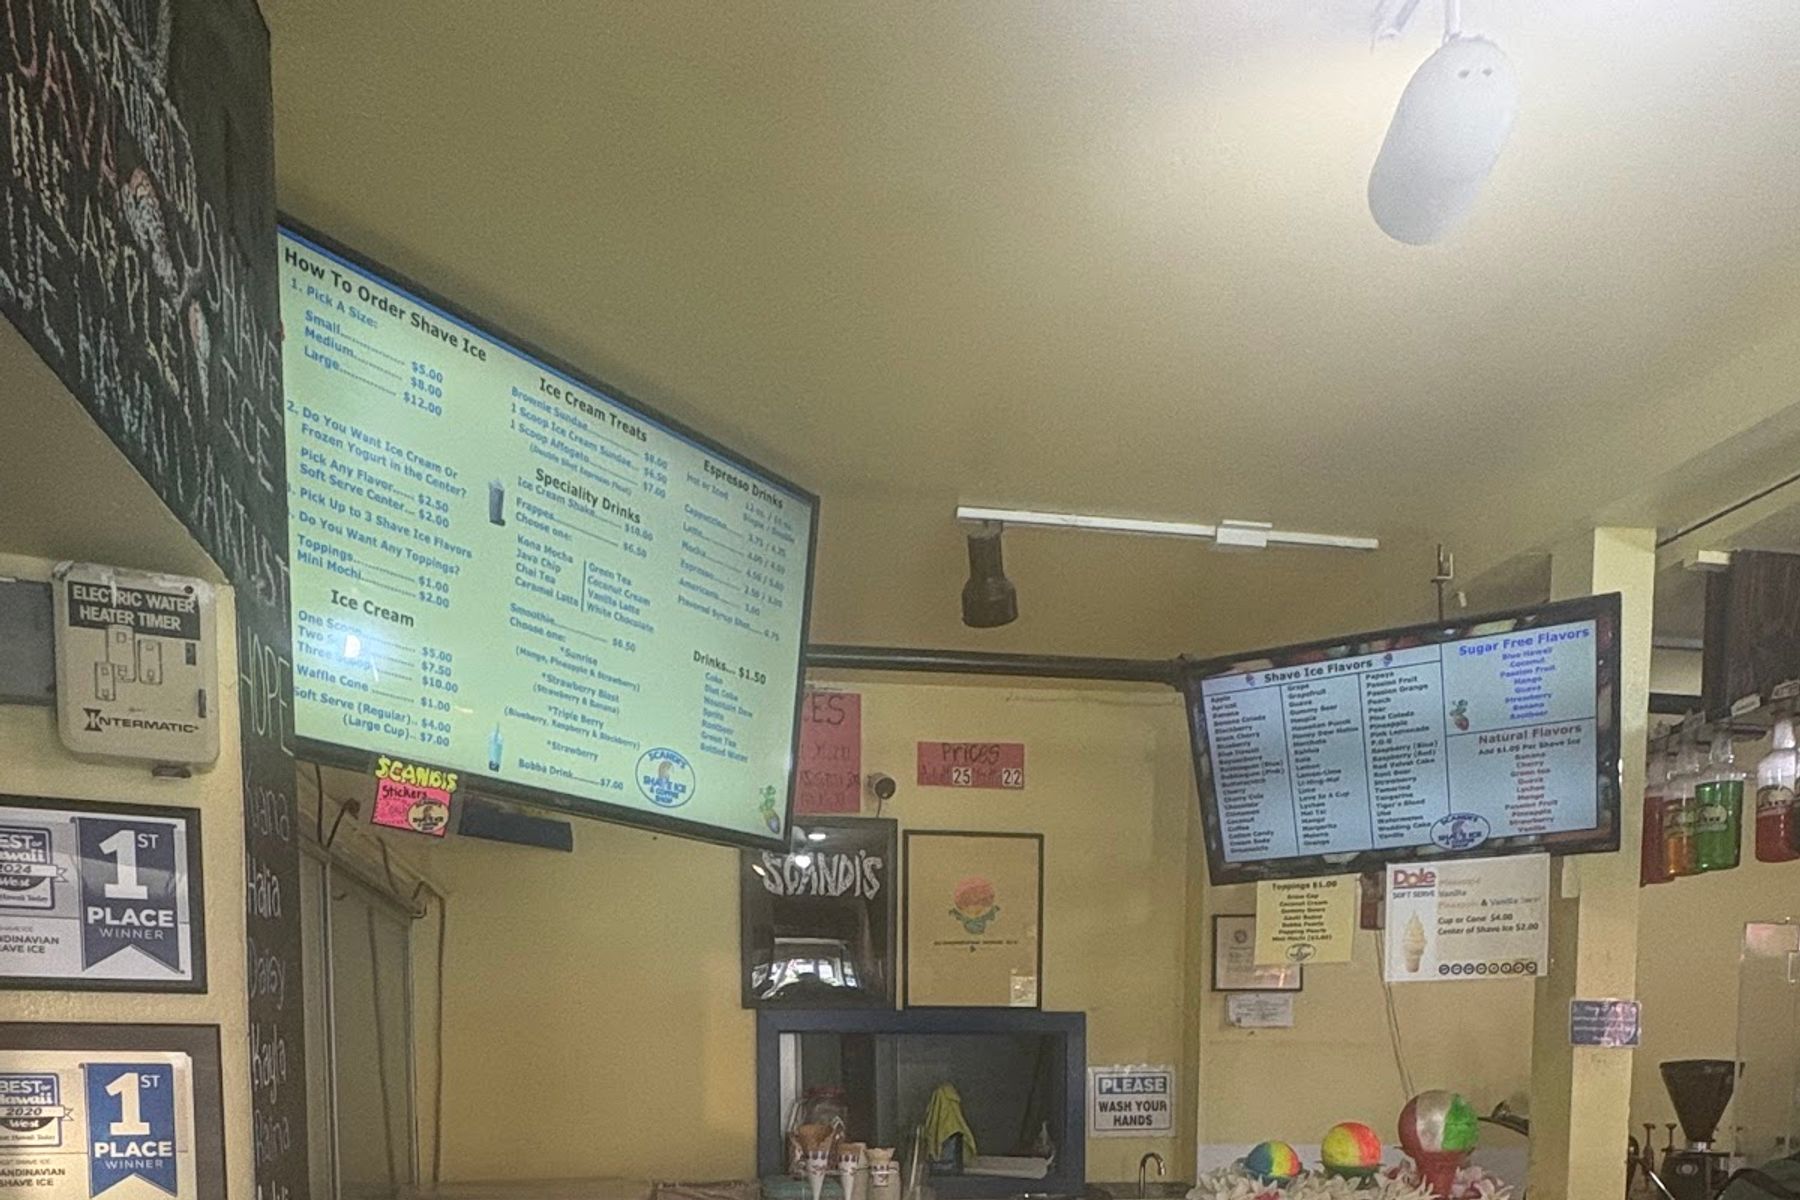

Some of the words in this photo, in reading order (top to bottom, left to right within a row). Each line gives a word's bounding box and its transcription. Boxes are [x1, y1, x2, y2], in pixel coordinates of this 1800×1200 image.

[203, 202, 283, 422] SHAVE
[285, 247, 325, 280] How
[330, 270, 352, 294] To
[358, 286, 406, 320] Order
[411, 312, 458, 347] Shave
[462, 337, 487, 361] Ice
[306, 285, 333, 307] Pick
[336, 301, 345, 313] A
[348, 306, 378, 328] Size:
[305, 326, 355, 358] Medium
[305, 310, 340, 335] Small
[411, 361, 444, 383] $5.00
[304, 346, 340, 372] Large
[403, 391, 443, 416] $12.00
[221, 355, 274, 493] ICE
[539, 377, 561, 399] Ice
[565, 391, 606, 421] Cream
[609, 412, 648, 442] Treats
[302, 406, 320, 423] Do
[323, 415, 347, 434] You
[350, 426, 382, 448] Want
[385, 441, 404, 458] Ice
[406, 450, 443, 473] Cream
[444, 467, 458, 480] Or
[301, 423, 344, 449] Frozen
[348, 441, 387, 467] Yogurt
[390, 459, 401, 471] in
[404, 463, 423, 482] the
[425, 473, 468, 498] Center?
[299, 463, 326, 482] Soft
[329, 475, 364, 497] Serve
[366, 488, 405, 513] Center
[418, 509, 450, 528] $2.00
[301, 447, 328, 466] Pick
[330, 459, 353, 478] Any
[418, 494, 449, 514] $2.50
[703, 459, 750, 494] Espresso
[752, 483, 784, 510] Drinks
[536, 468, 599, 508] Speciality
[602, 498, 641, 524] Drinks
[300, 488, 326, 507] Pick
[329, 497, 346, 514] Up
[349, 504, 362, 518] to
[364, 511, 372, 522] 3
[375, 516, 411, 537] Shave
[413, 528, 431, 546] Ice
[434, 537, 473, 559] Flavors
[299, 511, 317, 526] Do
[321, 518, 343, 536] You
[346, 527, 378, 547] Want
[380, 540, 403, 558] Any
[405, 549, 461, 575] Toppings?
[297, 534, 354, 562] Toppings
[418, 577, 450, 594] $1.00
[297, 550, 323, 568] Mini
[327, 560, 362, 581] Mochi
[419, 591, 450, 608] $2.00
[72, 585, 142, 609] ELECTRIC
[145, 594, 195, 614] WATER
[330, 590, 358, 610] Ice
[363, 600, 415, 627] Cream
[79, 607, 135, 626] HEATER
[138, 614, 181, 632] TIMER
[298, 610, 323, 627] One
[421, 647, 453, 663] $5.00
[1459, 641, 1499, 656] Sugar
[1503, 636, 1533, 649] Free
[1538, 628, 1590, 644] Flavors
[421, 661, 452, 677] $7.50
[738, 665, 767, 686] $1.50
[1264, 669, 1302, 683] Shave
[1304, 666, 1324, 678] Ice
[1327, 659, 1374, 674] Flavors
[240, 626, 294, 757] HOPE
[296, 663, 336, 684] Waffle
[340, 676, 369, 692] Cone
[420, 697, 451, 712] $1.00
[421, 676, 458, 693] $10.00
[83, 707, 198, 734] INTERMATIC
[320, 693, 355, 710] Serve
[421, 718, 451, 733] $4.00
[343, 713, 381, 732] (Large
[420, 732, 450, 747] $7.00
[1479, 730, 1528, 745] Natural
[1532, 724, 1582, 738] Flavors
[375, 755, 458, 793] SCANDIS
[953, 767, 970, 785] 25
[1003, 769, 1021, 785] 22
[382, 785, 428, 799] Stickers
[1393, 867, 1436, 887] Dole
[1392, 890, 1411, 899] SOFT
[88, 906, 174, 928] PLACE
[1438, 916, 1454, 925] Cup
[1456, 916, 1465, 924] or
[1466, 915, 1487, 924] Cone
[1490, 913, 1514, 922] $4.00
[1438, 927, 1465, 936] Center
[1466, 926, 1475, 934] of
[1476, 925, 1501, 934] Shave
[1502, 924, 1514, 932] Ice
[100, 928, 164, 940] WINNER
[1100, 1078, 1166, 1092] PLEASE
[6, 1107, 42, 1116] 2020
[1098, 1100, 1132, 1113] WASH
[1135, 1100, 1168, 1113] YOUR
[1113, 1114, 1153, 1127] HANDS
[9, 1118, 40, 1128] West
[94, 1141, 173, 1158] PLACE
[105, 1158, 164, 1169] WINNER
[36, 1178, 54, 1187] ICE
